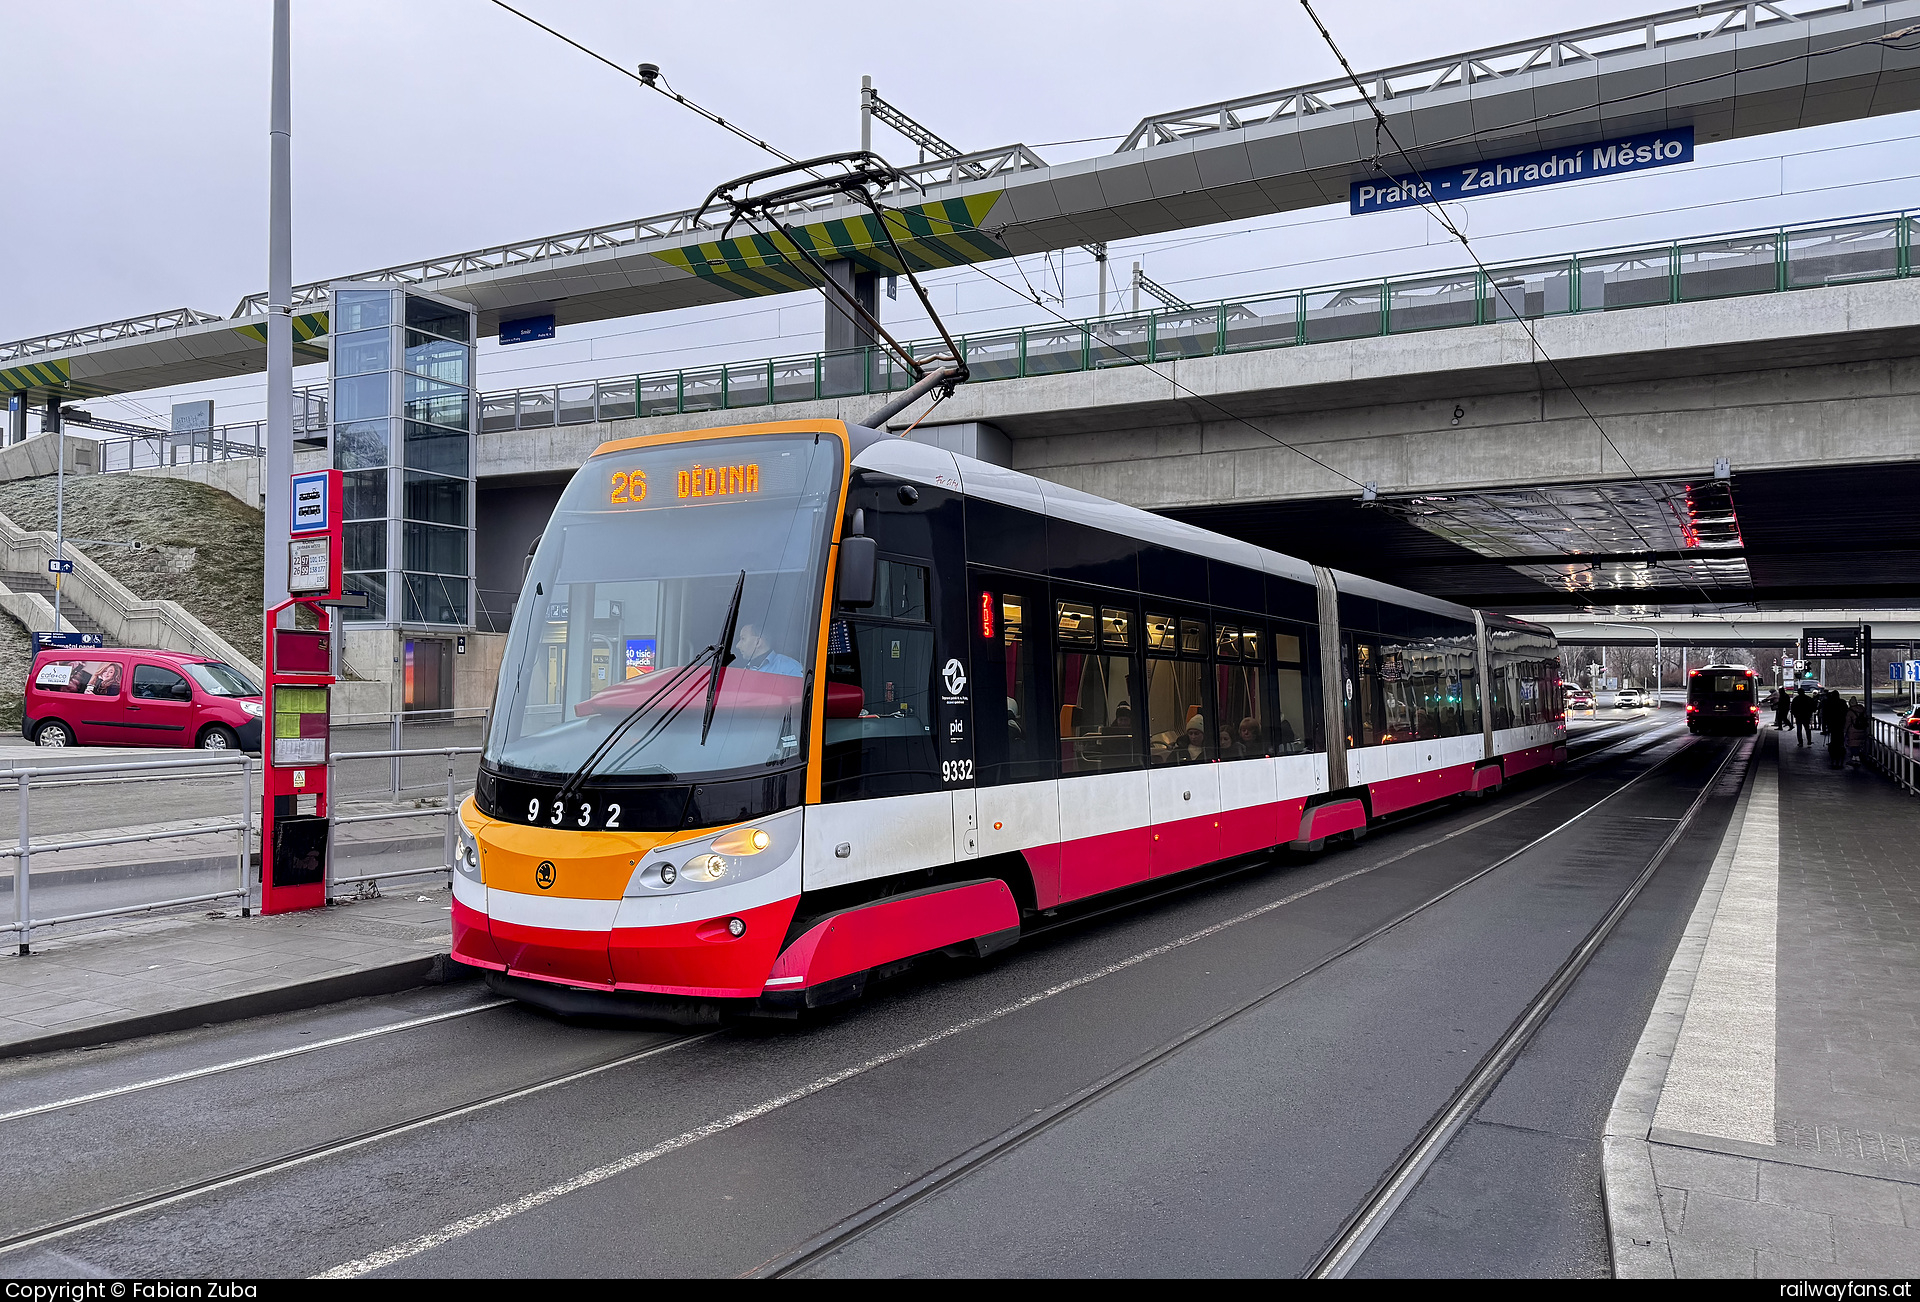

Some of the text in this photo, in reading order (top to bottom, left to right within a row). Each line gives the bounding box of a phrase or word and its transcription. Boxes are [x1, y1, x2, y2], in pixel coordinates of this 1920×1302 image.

[1359, 180, 1432, 207] Praha
[1461, 150, 1583, 191] Zahradní
[1592, 138, 1683, 171] Město
[611, 464, 759, 504] 26 DĚDINA
[294, 557, 300, 565] 22
[302, 556, 308, 565] 97
[294, 567, 300, 575] 26
[302, 566, 308, 574] 99
[636, 649, 651, 657] tisíc
[950, 719, 963, 735] pid
[942, 759, 974, 782] 9332
[527, 798, 621, 828] 9332
